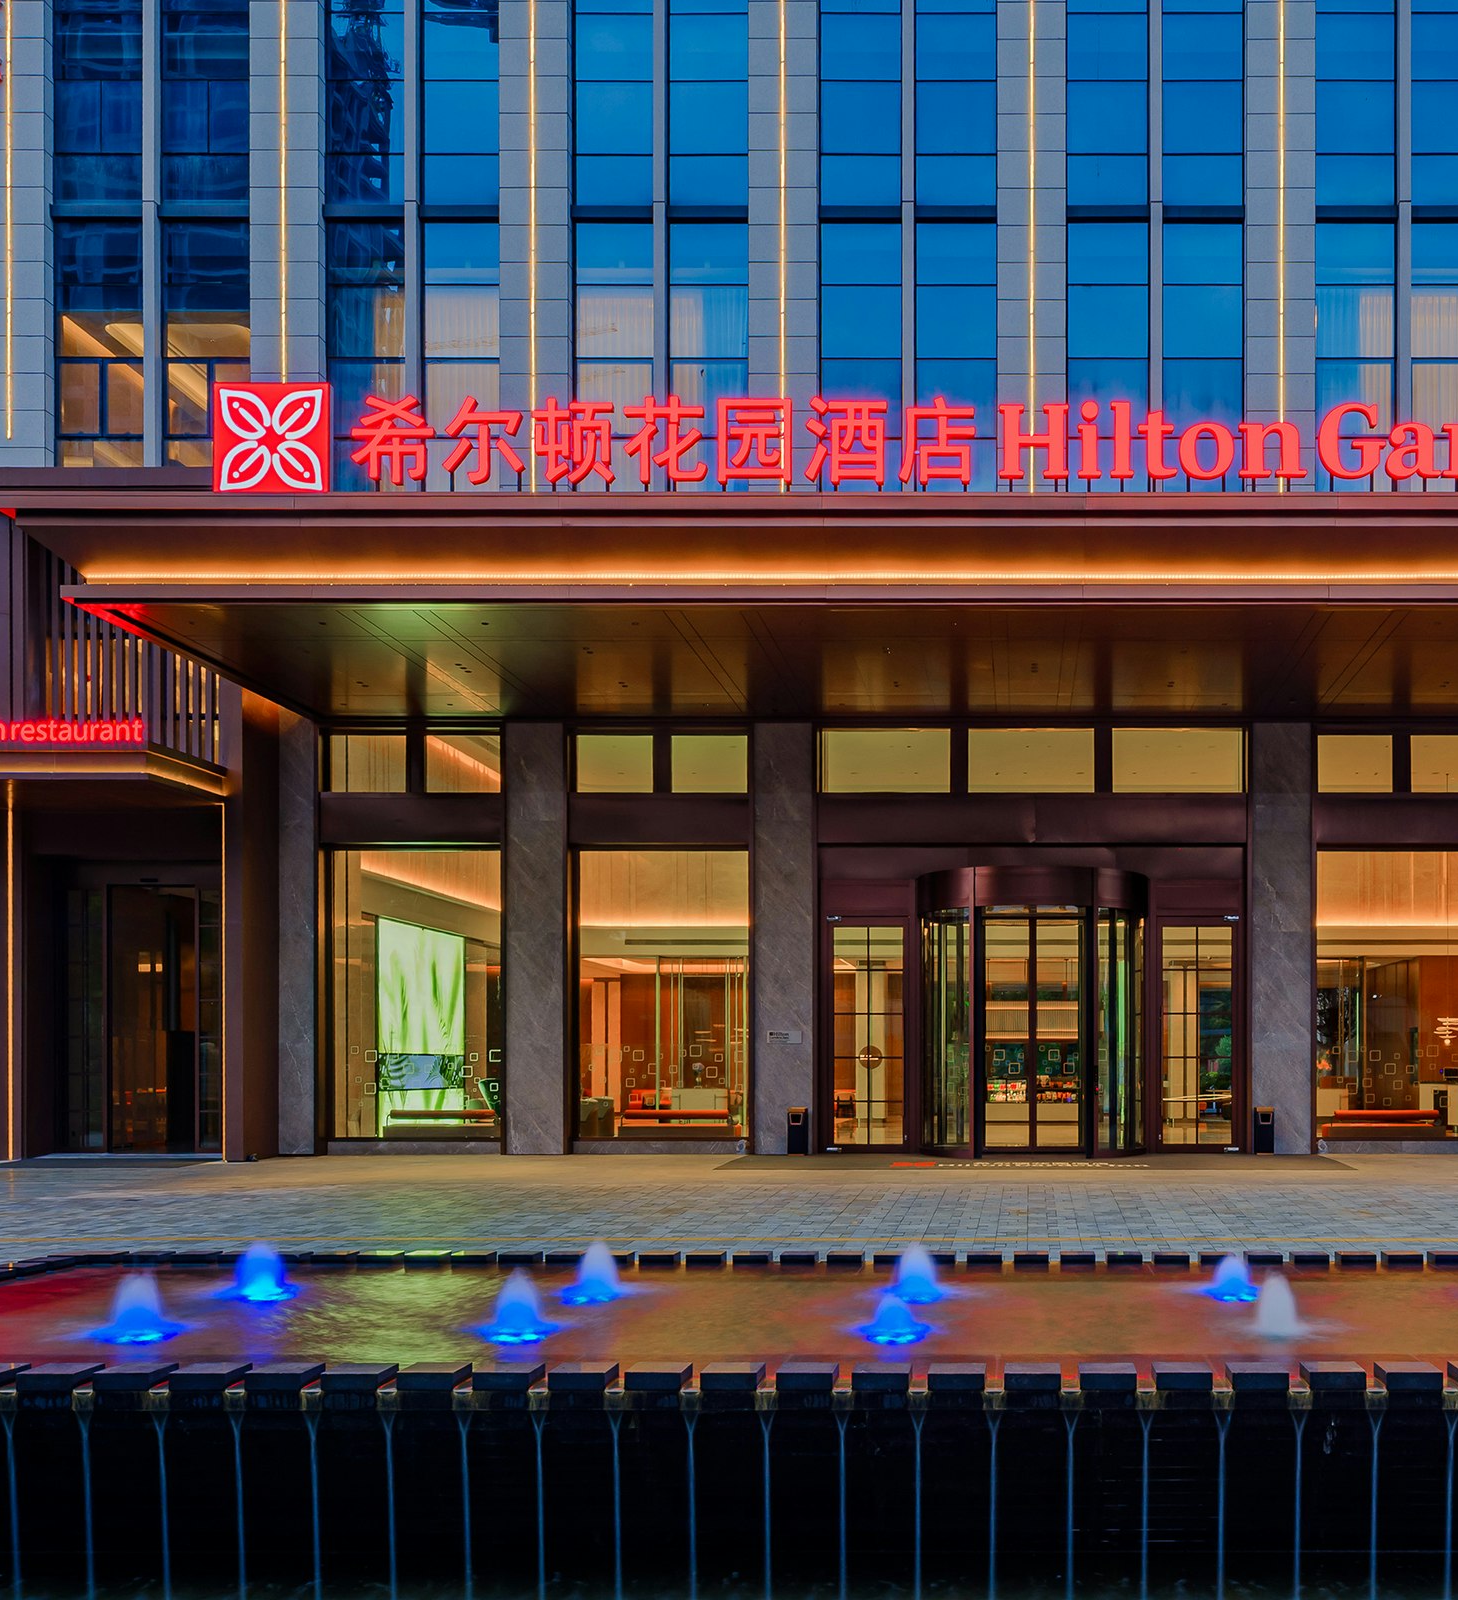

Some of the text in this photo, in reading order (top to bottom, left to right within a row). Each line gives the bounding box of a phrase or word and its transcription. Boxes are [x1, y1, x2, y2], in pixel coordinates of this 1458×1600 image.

[350, 394, 977, 486] 希尔顿花园酒店
[997, 400, 1308, 481] Hilton
[9, 719, 143, 742] restaurant
